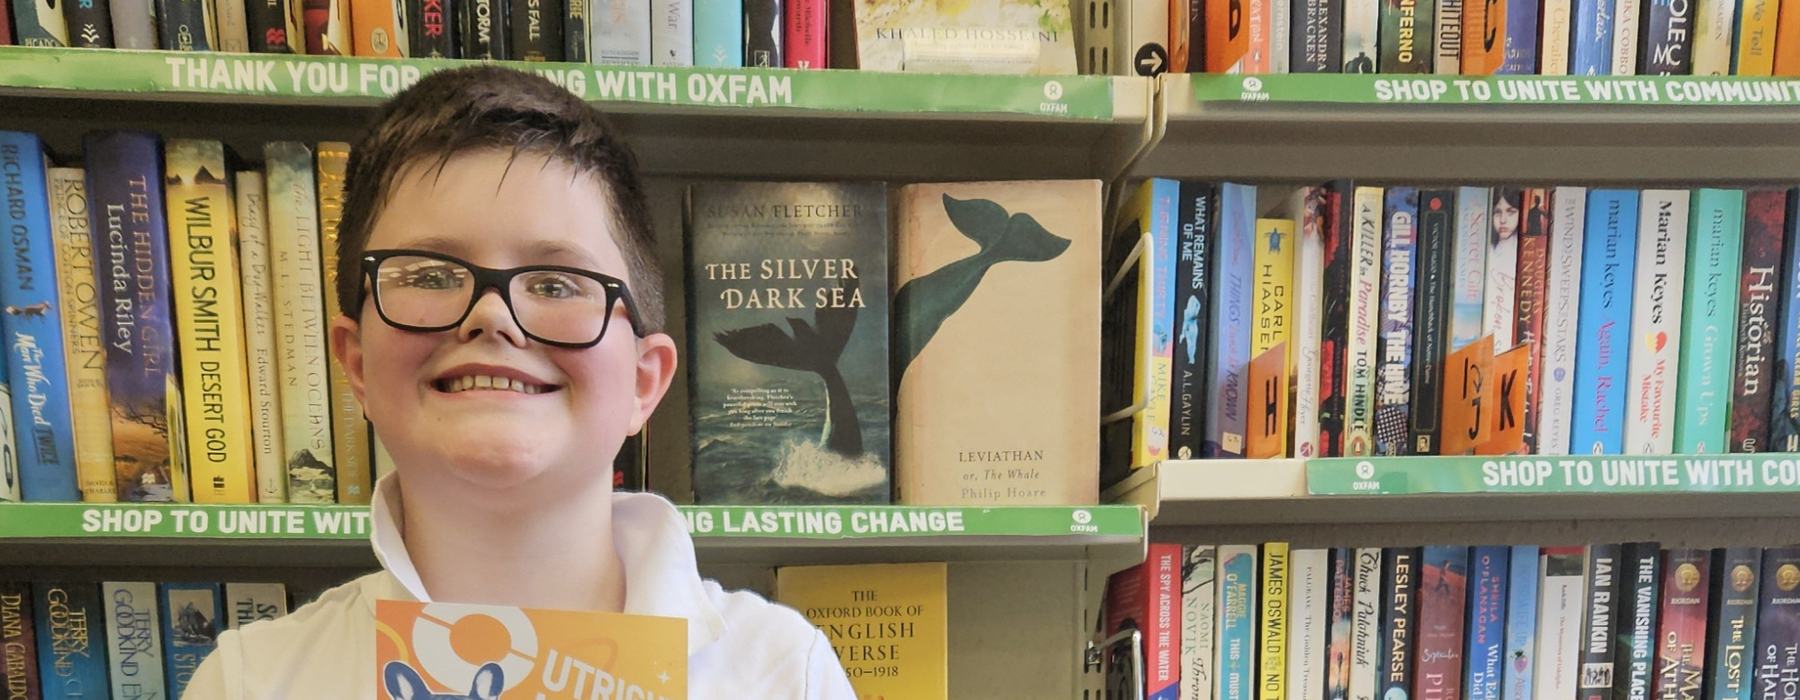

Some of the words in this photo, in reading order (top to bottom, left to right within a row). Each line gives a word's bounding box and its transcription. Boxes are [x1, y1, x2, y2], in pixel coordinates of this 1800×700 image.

[477, 0, 491, 42] TORM
[529, 10, 541, 42] FALL
[667, 3, 679, 31] War
[876, 27, 959, 42] KHALED
[965, 28, 1059, 43] HOSSEINI
[1305, 0, 1317, 63] BRACKEN
[1316, 0, 1329, 71] LEXANDRA
[1668, 0, 1688, 42] OLE
[1749, 29, 1764, 56] Tell
[164, 57, 277, 93] THANK
[285, 61, 348, 95] YOU
[598, 72, 677, 102] WITH
[687, 75, 793, 105] OXFAM
[1374, 79, 1448, 101] SHOP
[1453, 80, 1491, 101] TO
[1500, 80, 1580, 101] UNITE
[1584, 80, 1658, 101] WITH
[1040, 102, 1068, 114] OXFAM
[2, 143, 28, 219] RICHARD
[129, 175, 147, 224] THE
[63, 177, 94, 277] ROBERT
[707, 205, 765, 219] SUSAN
[772, 204, 862, 219] FLETCHER
[1183, 223, 1194, 240] OF
[1194, 196, 1206, 232] WHAT
[1391, 211, 1412, 248] GILL
[1606, 199, 1620, 259] marian
[1655, 200, 1673, 266] Marian
[10, 224, 35, 291] OSMAN
[106, 203, 133, 296] Lucinda
[185, 196, 216, 282] WILBUR
[296, 215, 314, 273] LIGHT
[1182, 242, 1193, 261] ME
[1359, 217, 1376, 267] KILLER
[1710, 208, 1724, 267] marian
[133, 231, 157, 324] HIDDEN
[705, 263, 751, 280] THE
[761, 259, 859, 280] SILVER
[1191, 234, 1205, 290] REMAINS
[1518, 236, 1538, 324] KENNEDY
[1533, 248, 1545, 315] DOUGLAS
[720, 288, 806, 310] DARK
[816, 287, 866, 309] SEA
[1228, 272, 1242, 325] THINGS
[1387, 250, 1411, 321] HORNBY
[1602, 262, 1620, 309] keyes
[1652, 272, 1672, 324] Keyes
[1704, 271, 1722, 318] keyes
[72, 281, 103, 371] OWEN
[113, 298, 135, 355] Riley
[192, 286, 221, 352] SMITH
[298, 282, 321, 366] BETWEEN
[1272, 285, 1284, 341] CARL
[1355, 280, 1372, 346] Paradise
[1743, 265, 1775, 396] Historian
[14, 331, 34, 364] Man
[141, 325, 162, 377] GIRL
[282, 300, 298, 388] STEDMAN
[1385, 331, 1409, 362] THE
[1554, 318, 1569, 363] STARS
[23, 363, 51, 393] Who
[256, 348, 271, 396] Edward
[1157, 362, 1168, 401] MIKE
[1356, 350, 1368, 379] TOM
[1383, 363, 1410, 405] HIVE
[29, 393, 51, 426] Died
[200, 360, 227, 424] DESERT
[305, 372, 326, 450] OCEANS
[1225, 370, 1240, 421] KNOWN
[1264, 376, 1278, 438] H
[1353, 383, 1367, 431] HINDLE
[1499, 369, 1518, 431] K
[1593, 375, 1613, 433] Rachel
[1640, 374, 1652, 423] Mistake
[1650, 377, 1666, 439] Favourite
[259, 400, 276, 455] Stourton
[1468, 400, 1481, 440] J
[33, 427, 60, 465] TWICE
[205, 427, 227, 464] GOD
[959, 450, 1044, 463] LEVIATHAN
[961, 487, 1001, 500] Philip
[1007, 487, 1046, 498] Hoare
[984, 470, 1002, 481] The
[1007, 469, 1040, 480] Whale
[1353, 482, 1380, 490] OXFAM
[1482, 460, 1551, 486] SHOP
[1559, 460, 1593, 486] TO
[1602, 460, 1680, 486] UNITE
[1685, 460, 1754, 485] WITH
[1761, 460, 1800, 485] CO
[82, 509, 163, 532] SHOP
[170, 510, 209, 533] TO
[218, 510, 305, 534] UNITE
[312, 511, 370, 535] WIT
[723, 511, 842, 534] LASTING
[851, 511, 964, 533] CHANGE
[1071, 524, 1098, 533] OXFAM
[1160, 575, 1172, 591] SPY
[1161, 555, 1172, 571] THE
[1268, 553, 1283, 595] JAMES
[1358, 552, 1380, 593] Chuck
[1393, 555, 1409, 614] LESLEY
[1594, 557, 1613, 587] IAN
[1638, 556, 1655, 583] THE
[1, 593, 22, 639] DIANA
[806, 606, 862, 618] OXFORD
[865, 606, 903, 617] BOOK
[906, 605, 925, 616] OF
[852, 590, 877, 602] THE
[1159, 595, 1172, 629] ACROSS
[1225, 573, 1238, 631] O'FARRELL
[1238, 583, 1248, 619] MAGGIE
[1477, 555, 1490, 645] O'FLANAGAN
[1489, 577, 1500, 623] SHEILA
[47, 588, 74, 678] GOODKIND
[68, 608, 90, 659] TERRY
[112, 588, 139, 678] GOODKIND
[134, 608, 154, 659] TERRY
[1158, 631, 1170, 648] THE
[1185, 597, 1198, 656] NOVIK
[1200, 602, 1209, 649] NAOMI
[1266, 599, 1282, 653] OSWALD
[1304, 615, 1312, 631] The
[1356, 600, 1375, 669] Palahniuk
[1590, 591, 1611, 654] RANKIN
[1632, 586, 1653, 659] VANISHING
[1667, 631, 1678, 653] OF
[1730, 615, 1744, 642] THE
[833, 645, 900, 661] VERSE
[1158, 651, 1170, 681] WATER
[1229, 639, 1241, 660] THIS
[1390, 618, 1408, 682] PEARSE
[1486, 643, 1499, 678] What
[1681, 640, 1694, 666] THE
[1724, 644, 1745, 693] LOST
[1766, 645, 1777, 663] OF
[1784, 643, 1798, 666] THE
[1265, 673, 1280, 692] NO
[1473, 672, 1484, 696] Did
[1630, 662, 1647, 700] PLACE
